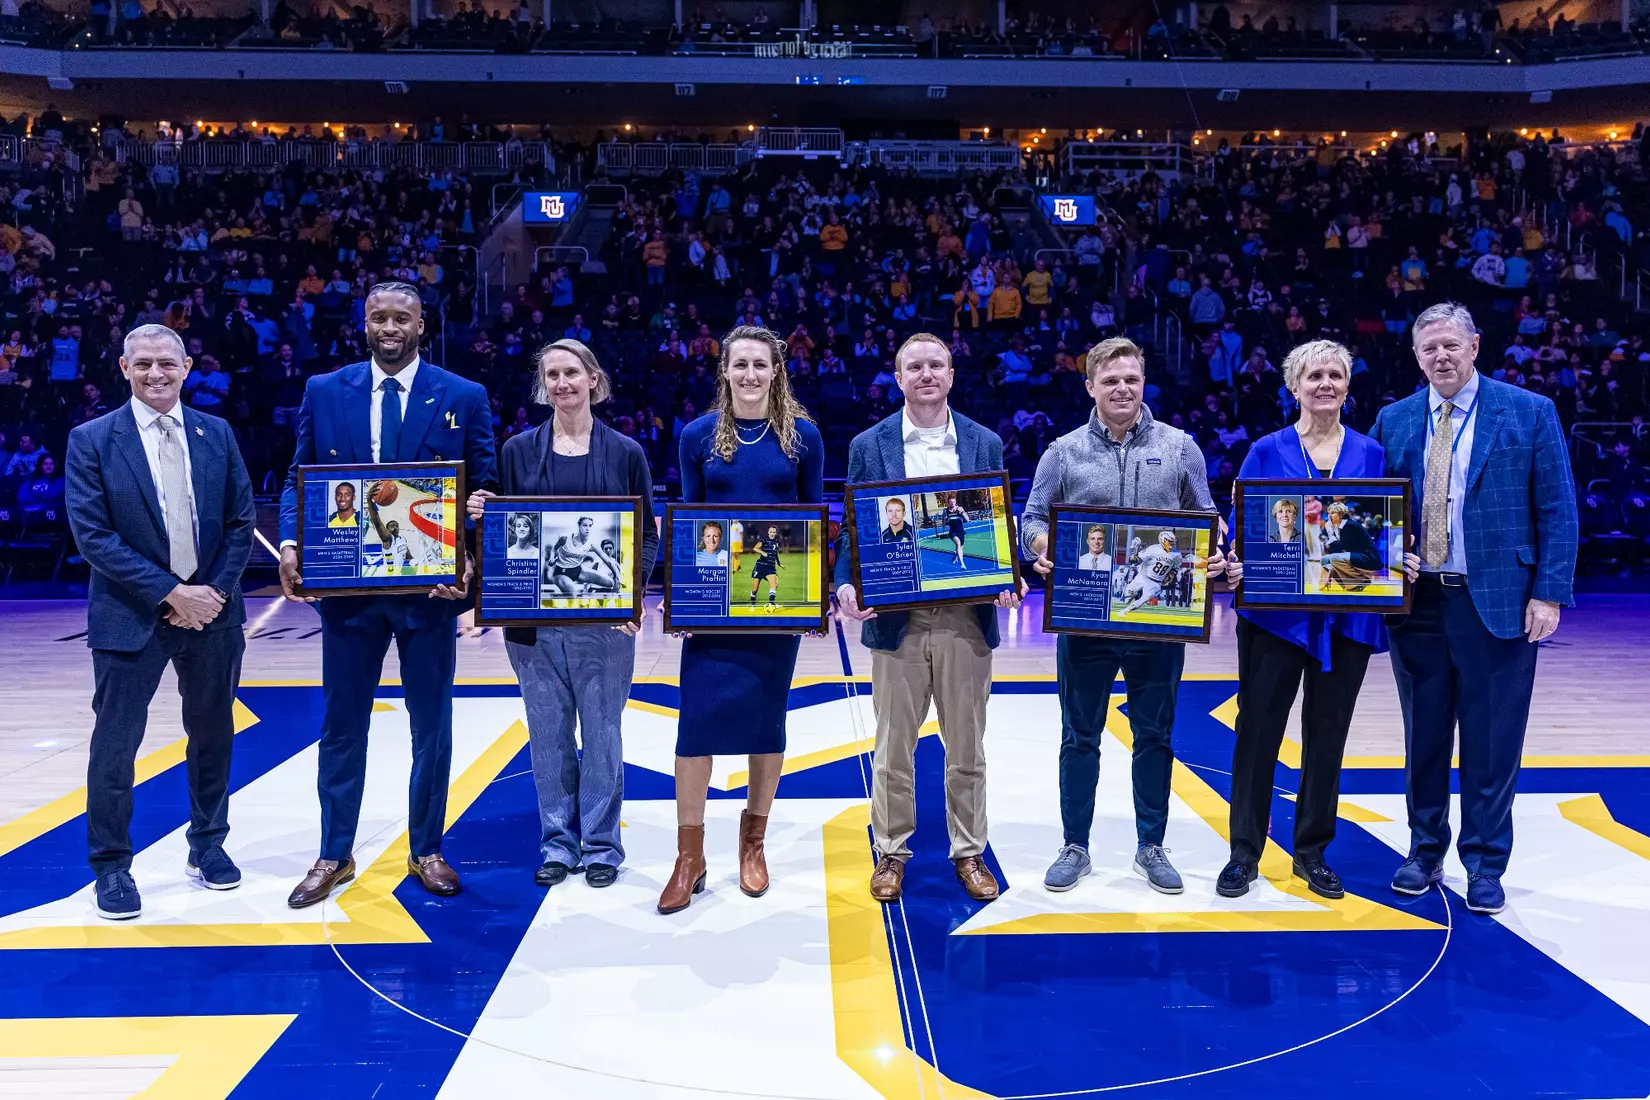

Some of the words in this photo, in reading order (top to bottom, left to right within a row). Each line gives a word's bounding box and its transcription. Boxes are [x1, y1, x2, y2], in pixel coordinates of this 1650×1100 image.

[540, 195, 565, 219] MU
[1053, 198, 1078, 222] MU
[332, 528, 359, 537] Wesley
[323, 536, 359, 544] Matthews
[895, 543, 913, 551] Tyler
[886, 551, 914, 560] O'Brien
[1270, 551, 1301, 559] Mitchell
[507, 567, 538, 576] Spindler
[697, 567, 726, 577] Morgan
[1091, 571, 1108, 580] Ryan
[1067, 577, 1108, 587] McNamara
